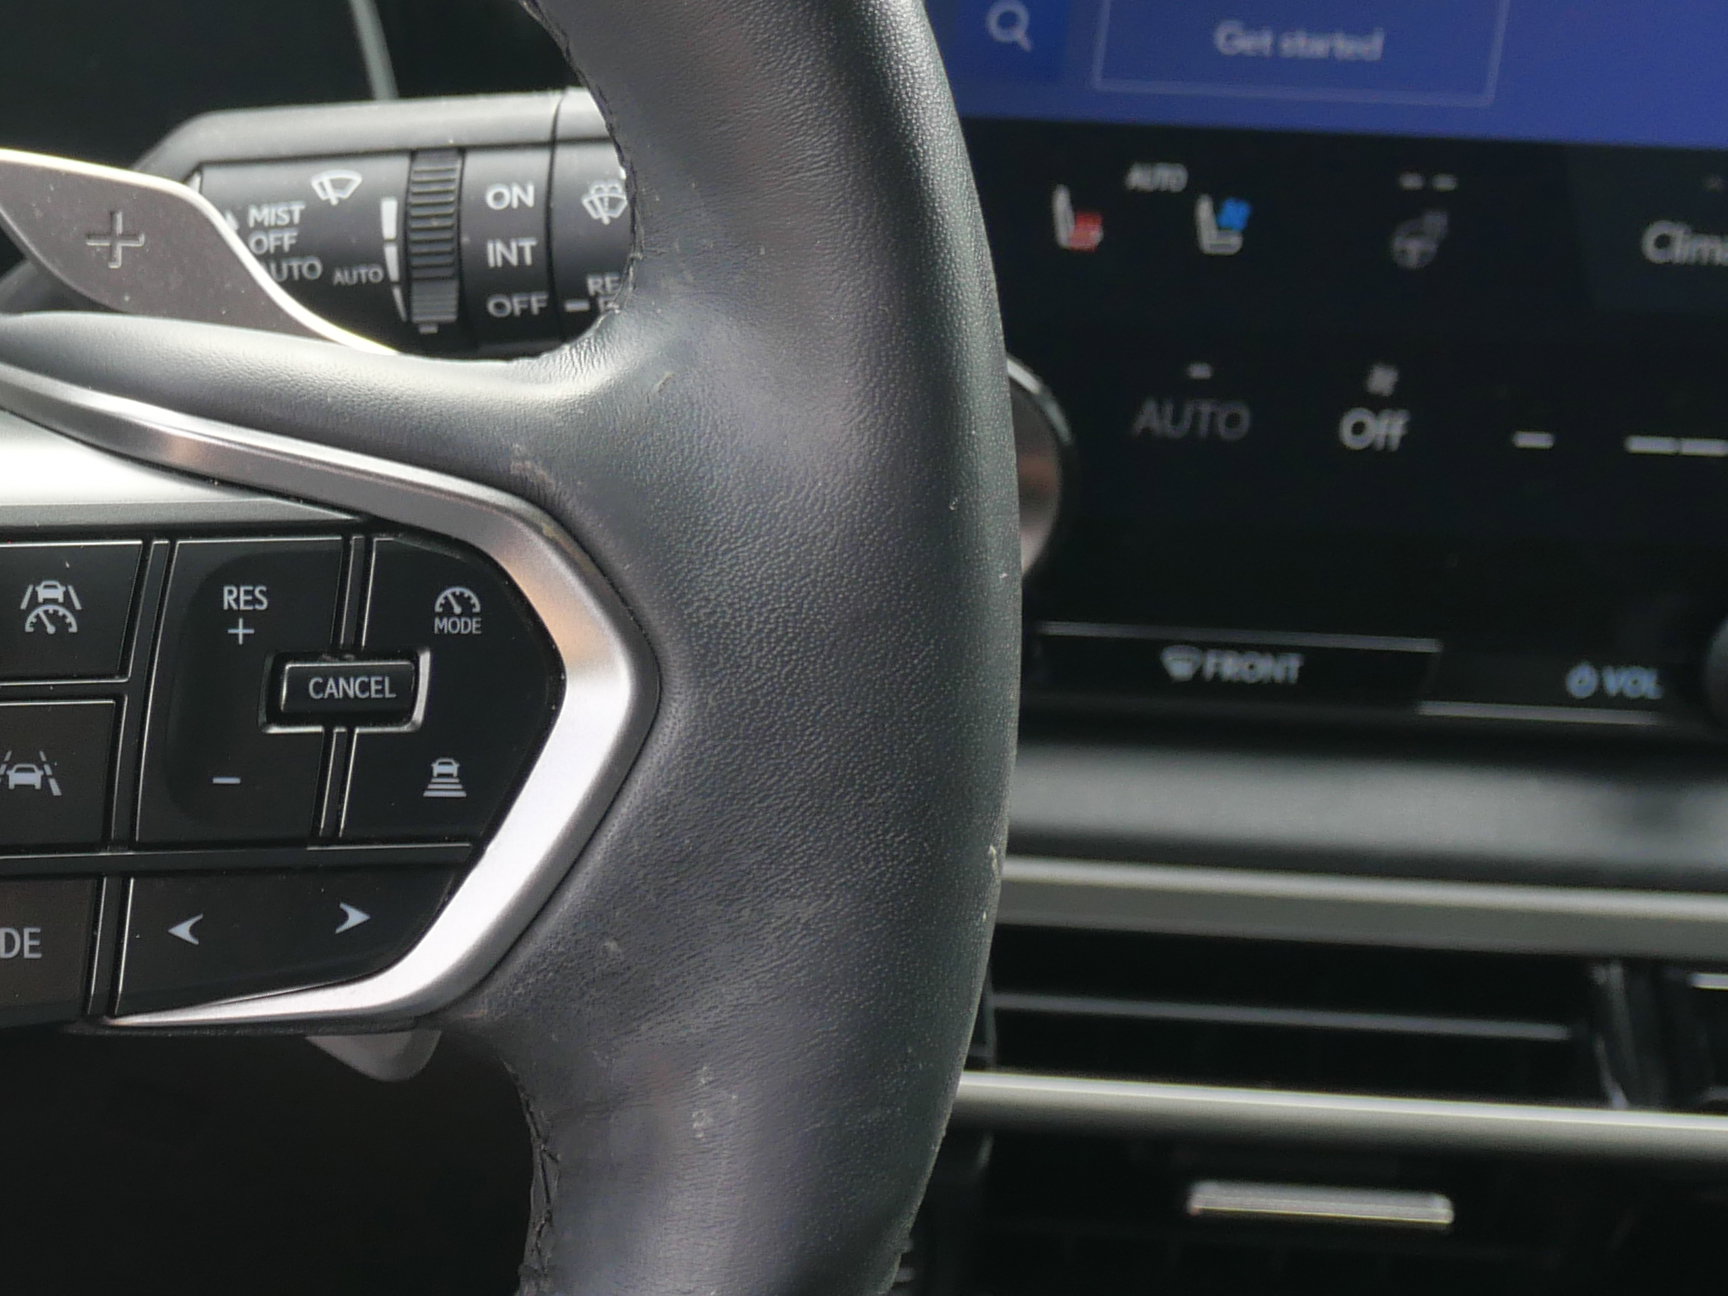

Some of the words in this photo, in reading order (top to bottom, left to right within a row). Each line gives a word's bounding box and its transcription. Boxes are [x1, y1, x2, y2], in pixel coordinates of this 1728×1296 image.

[1214, 19, 1273, 57] Get
[1279, 27, 1385, 61] started
[1125, 162, 1188, 192] AUTO
[486, 181, 535, 210] ON
[248, 201, 306, 228] MIST
[248, 227, 298, 255] OFF
[487, 237, 538, 268] INT
[1642, 220, 1728, 266] Clim
[261, 255, 323, 283] UTO
[333, 264, 385, 286] AUTO
[487, 291, 549, 317] OFF
[1132, 398, 1251, 441] AUTO
[1340, 407, 1410, 451] Off
[222, 585, 269, 611] RES
[433, 617, 482, 635] MODE
[1203, 649, 1304, 684] FRONT
[308, 676, 397, 699] CANCEL
[1602, 665, 1663, 699] VOL
